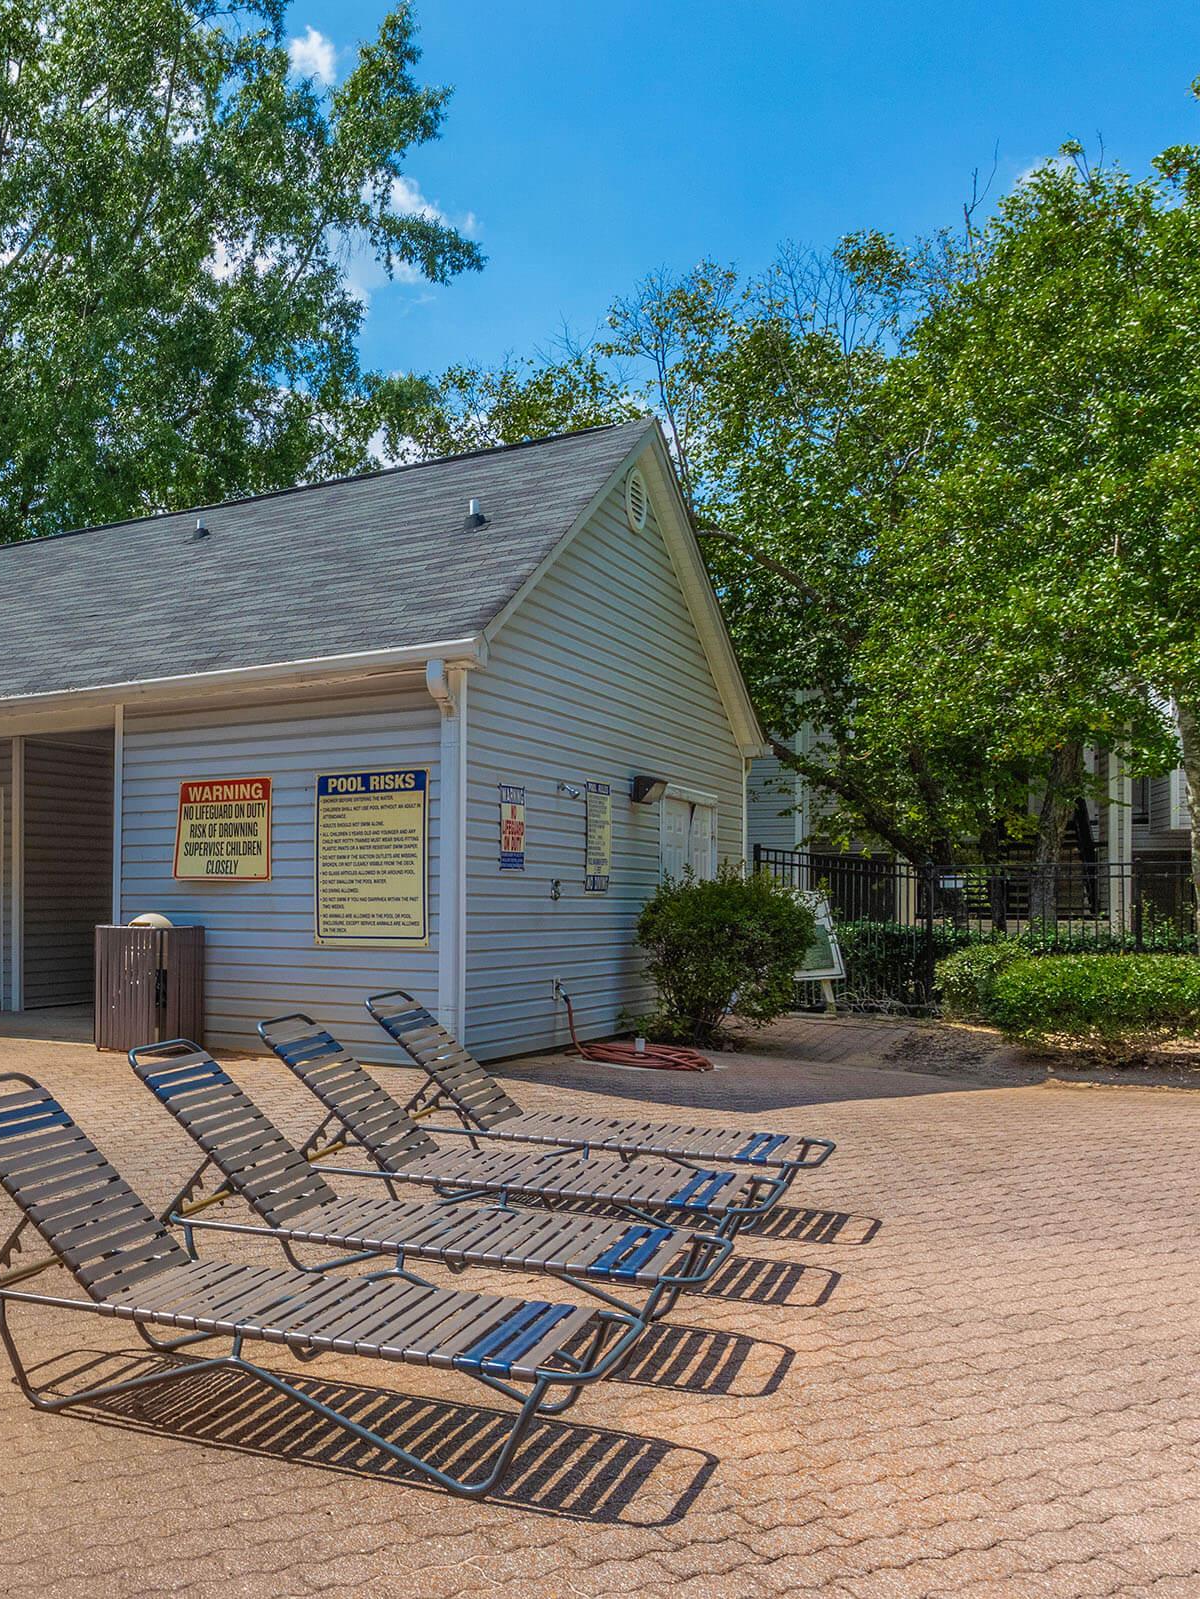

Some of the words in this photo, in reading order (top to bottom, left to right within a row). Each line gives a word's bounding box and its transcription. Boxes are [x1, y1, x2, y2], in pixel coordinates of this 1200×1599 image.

[328, 776, 366, 793] POOL
[370, 774, 415, 790] RISKS
[188, 783, 263, 801] WARNING
[184, 806, 193, 820] NO
[196, 804, 233, 820] LIFEGUARD
[235, 804, 245, 818] ON
[247, 803, 266, 818] DUTY
[511, 806, 516, 819] NO
[190, 823, 206, 838] RISK
[209, 823, 217, 838] OF
[219, 822, 258, 838] DROWNING
[184, 842, 224, 856] SUPERVISE
[226, 841, 262, 856] CHILDREN
[504, 836, 510, 851] ON
[511, 837, 521, 851] DUTY
[206, 860, 238, 874] CLOSELY
